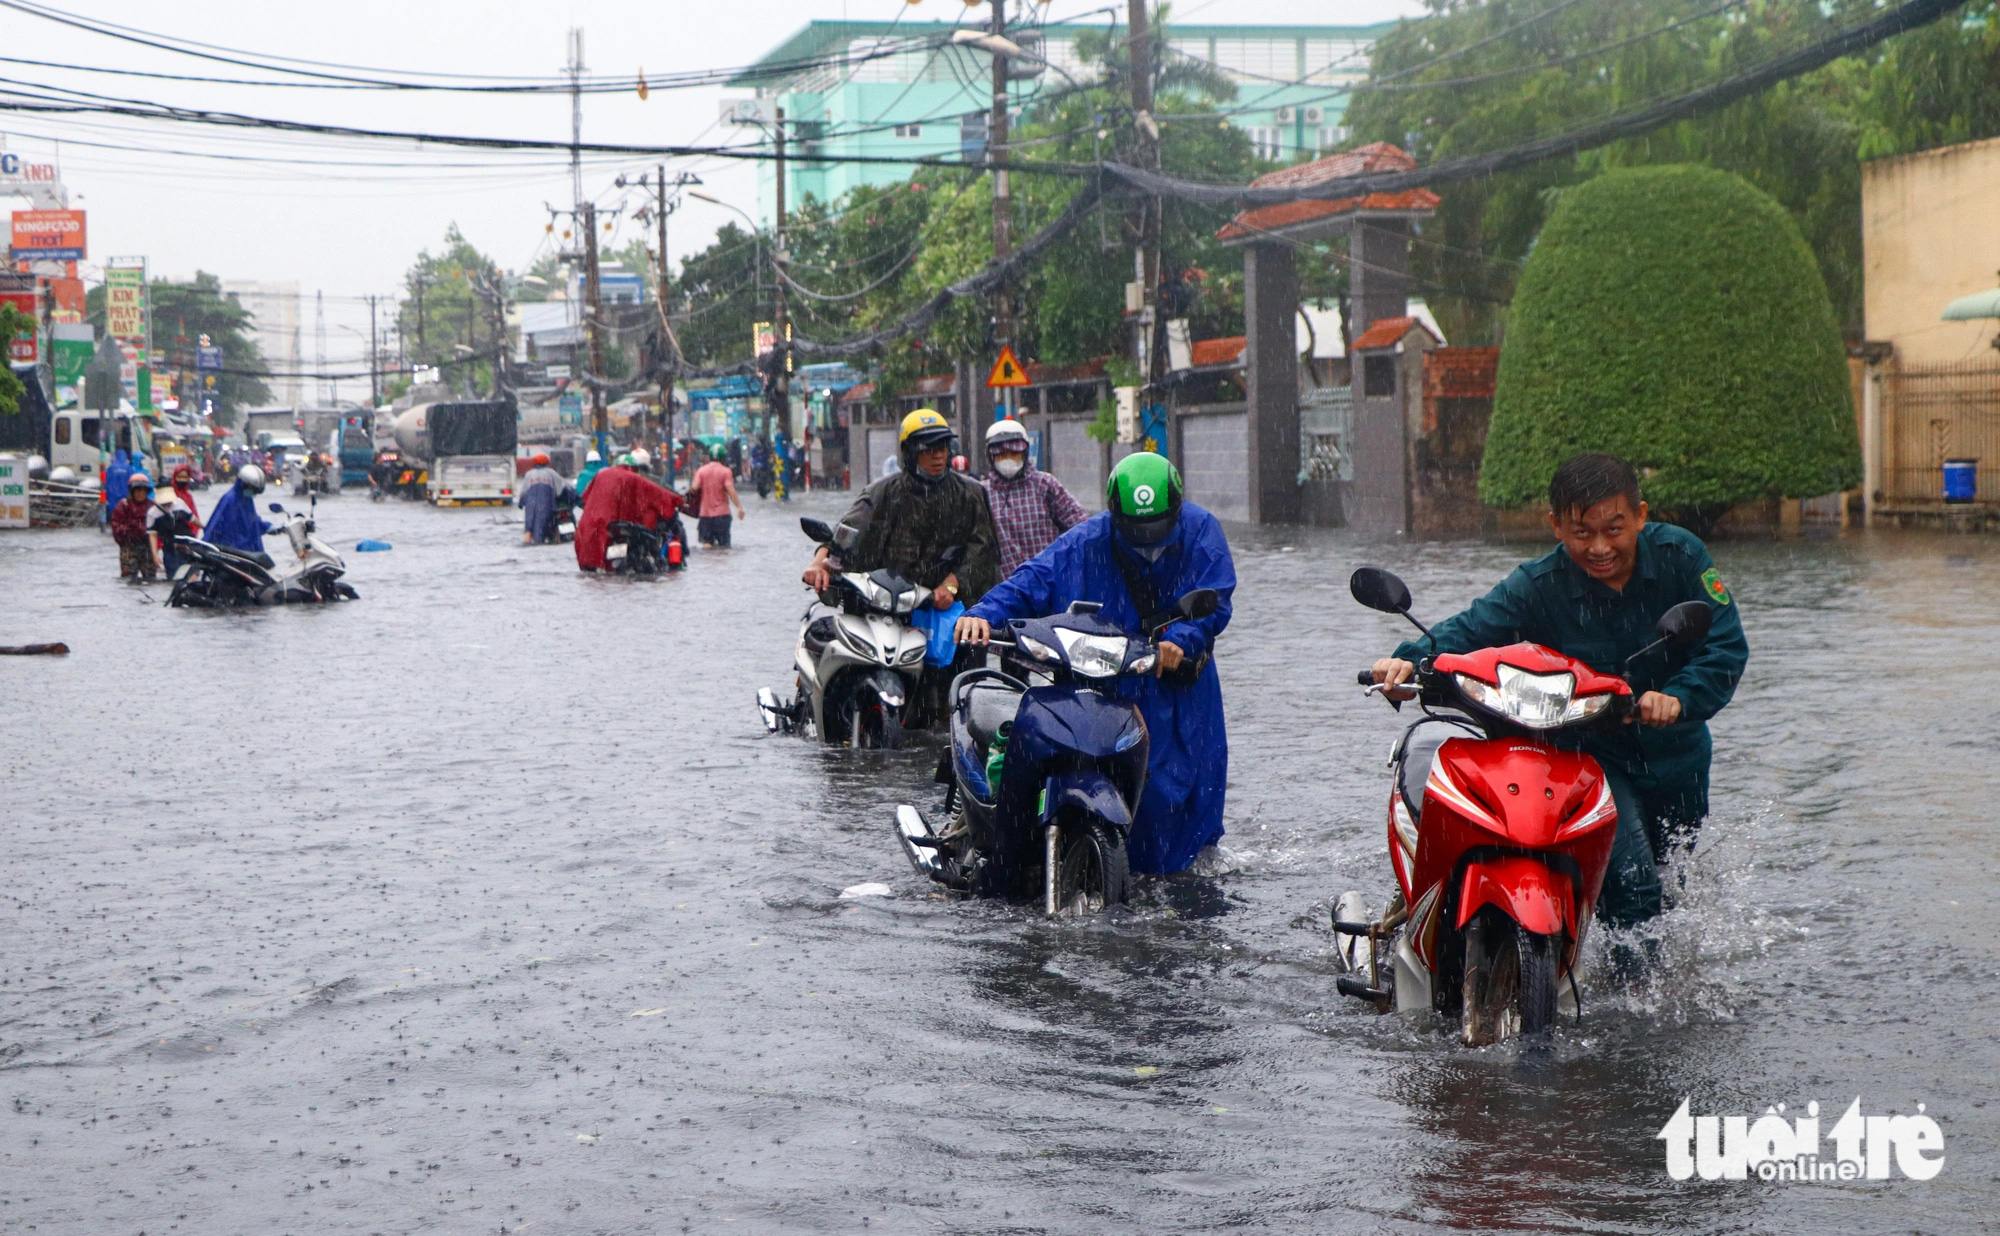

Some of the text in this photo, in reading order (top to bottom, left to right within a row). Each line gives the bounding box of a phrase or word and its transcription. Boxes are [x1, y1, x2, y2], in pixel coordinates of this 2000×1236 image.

[15, 220, 80, 233] KINGFOOD
[31, 232, 64, 247] mart
[113, 289, 133, 302] KIM
[1136, 506, 1154, 515] gojek
[1075, 688, 1103, 696] HONDA
[1509, 745, 1547, 755] HONDA
